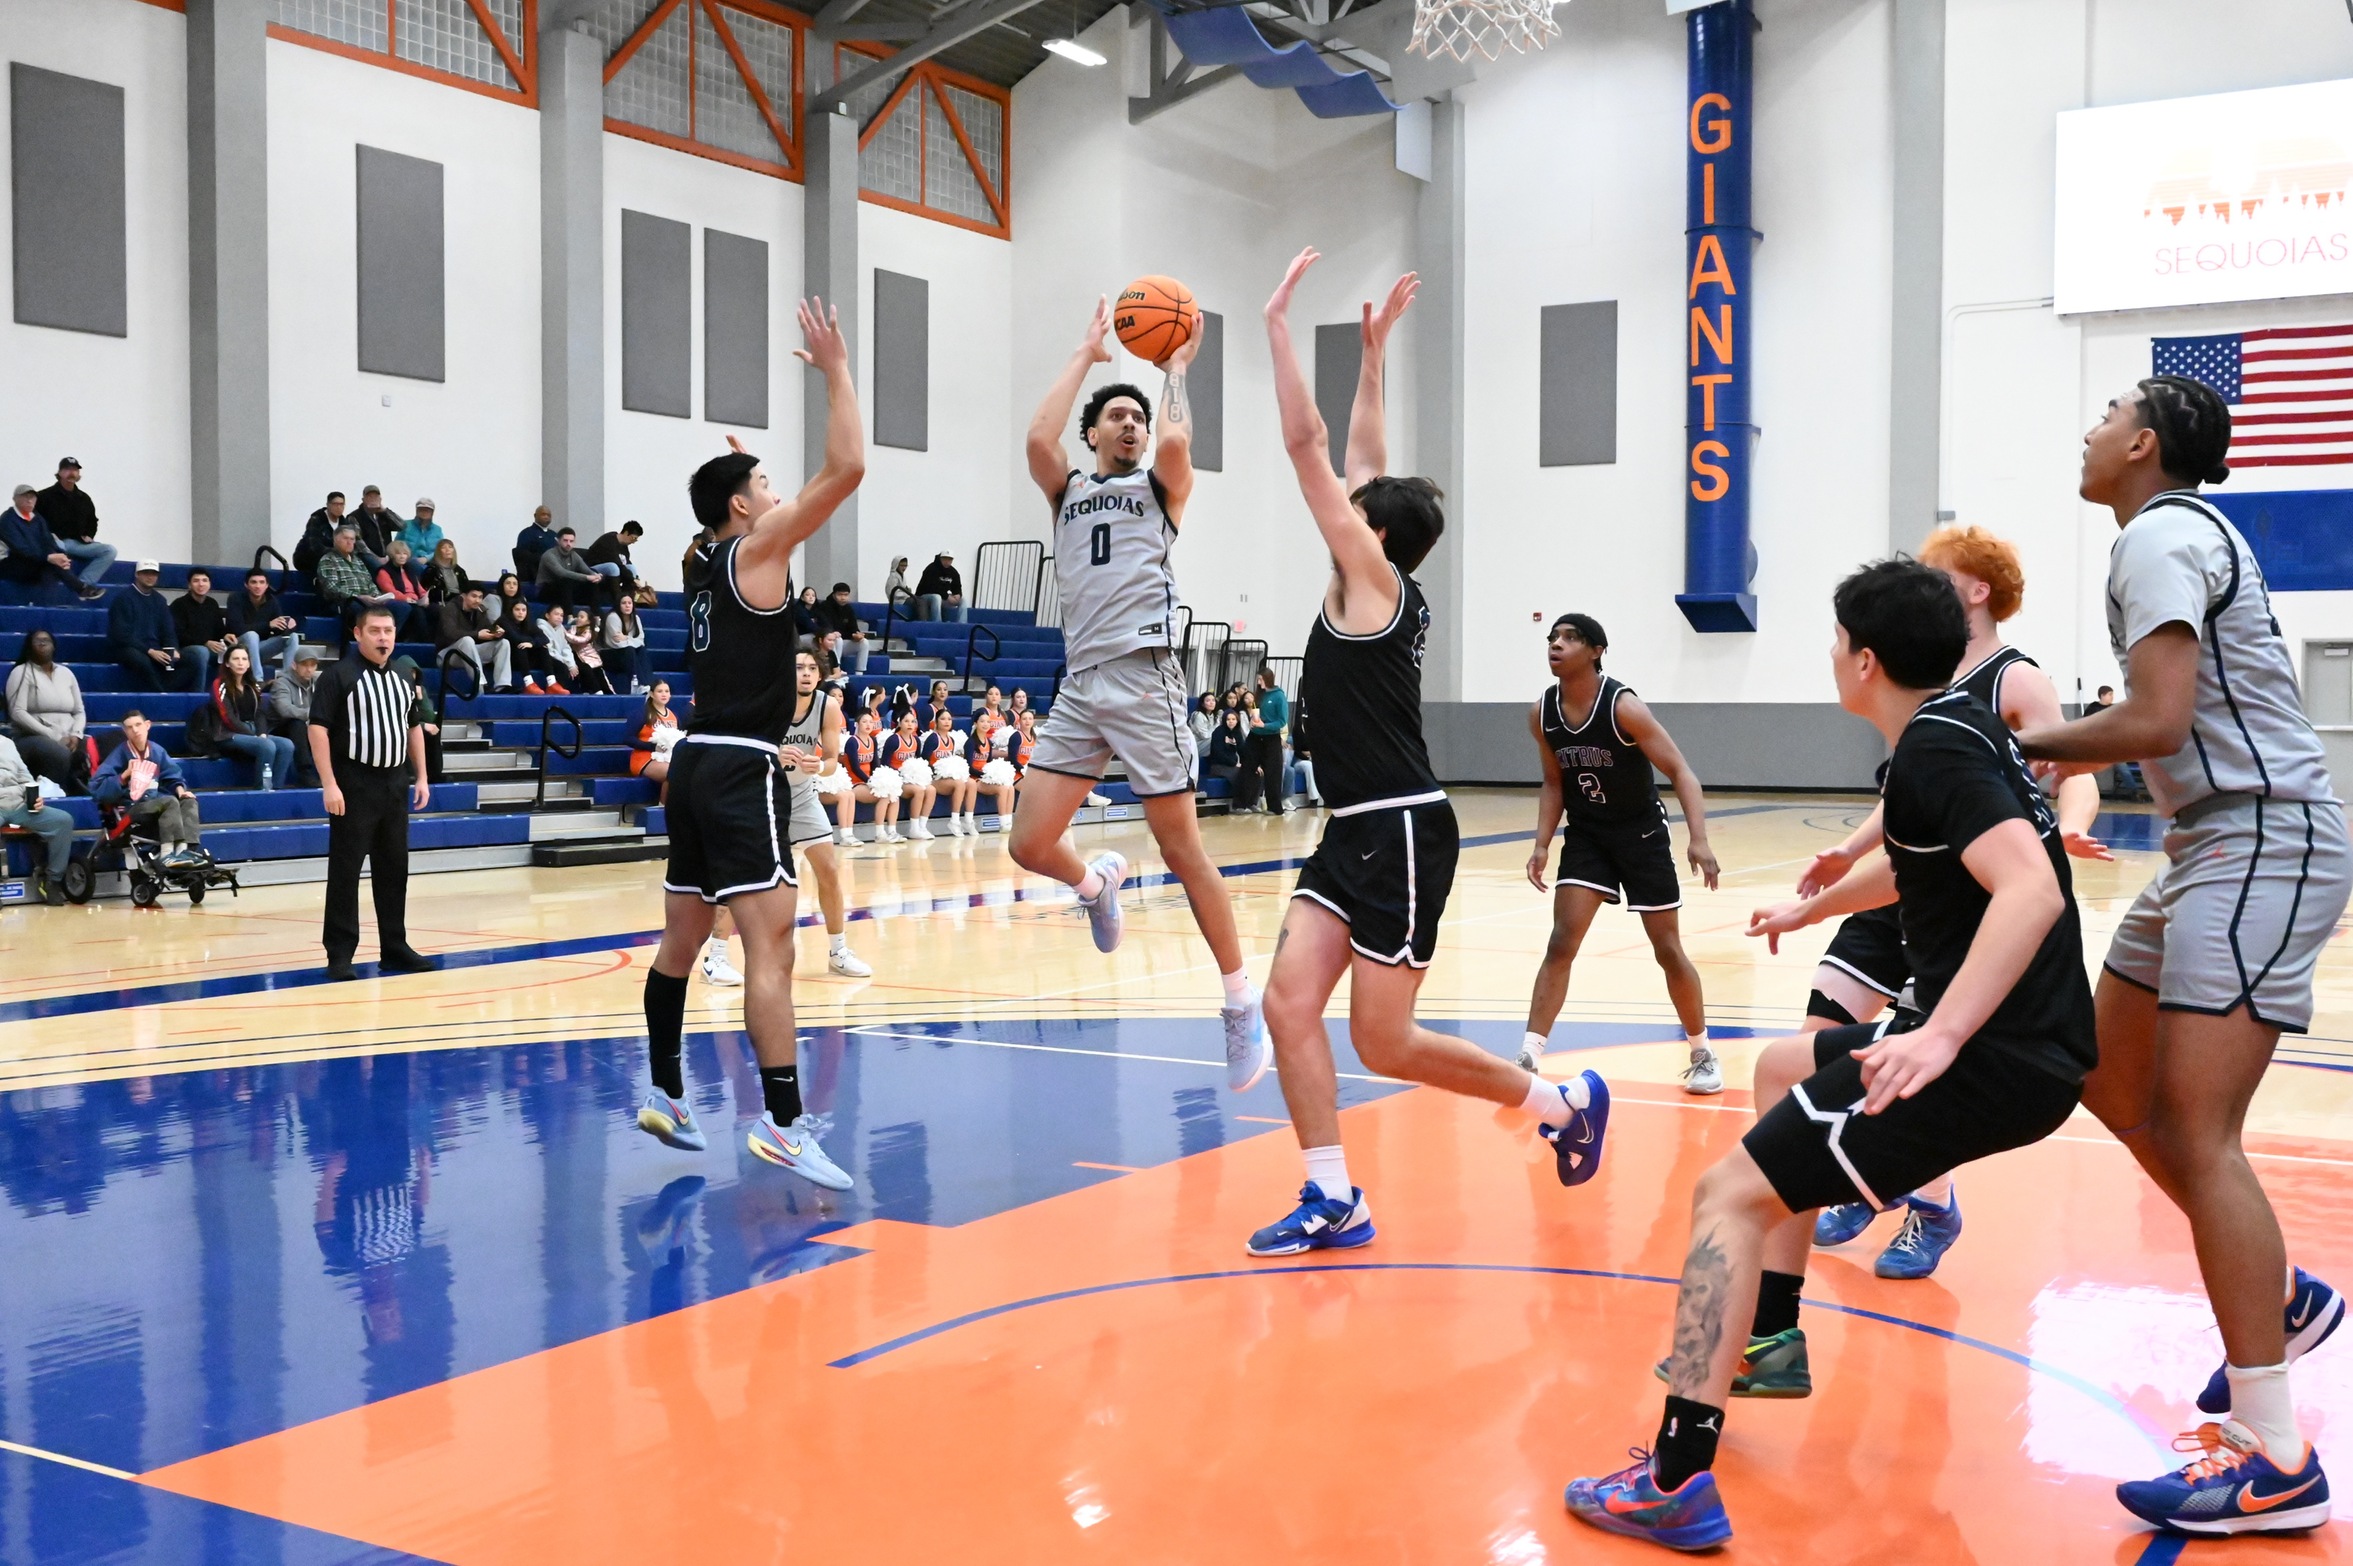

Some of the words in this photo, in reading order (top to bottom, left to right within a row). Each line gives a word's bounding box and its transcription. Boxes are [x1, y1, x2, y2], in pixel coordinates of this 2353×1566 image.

[2155, 233, 2348, 275] SEQUOIAS
[1689, 93, 1736, 501] GIANTS
[1091, 522, 1110, 566] 0
[690, 590, 712, 652] 8
[781, 734, 818, 746] QUOIA
[1578, 773, 1606, 804] 2
